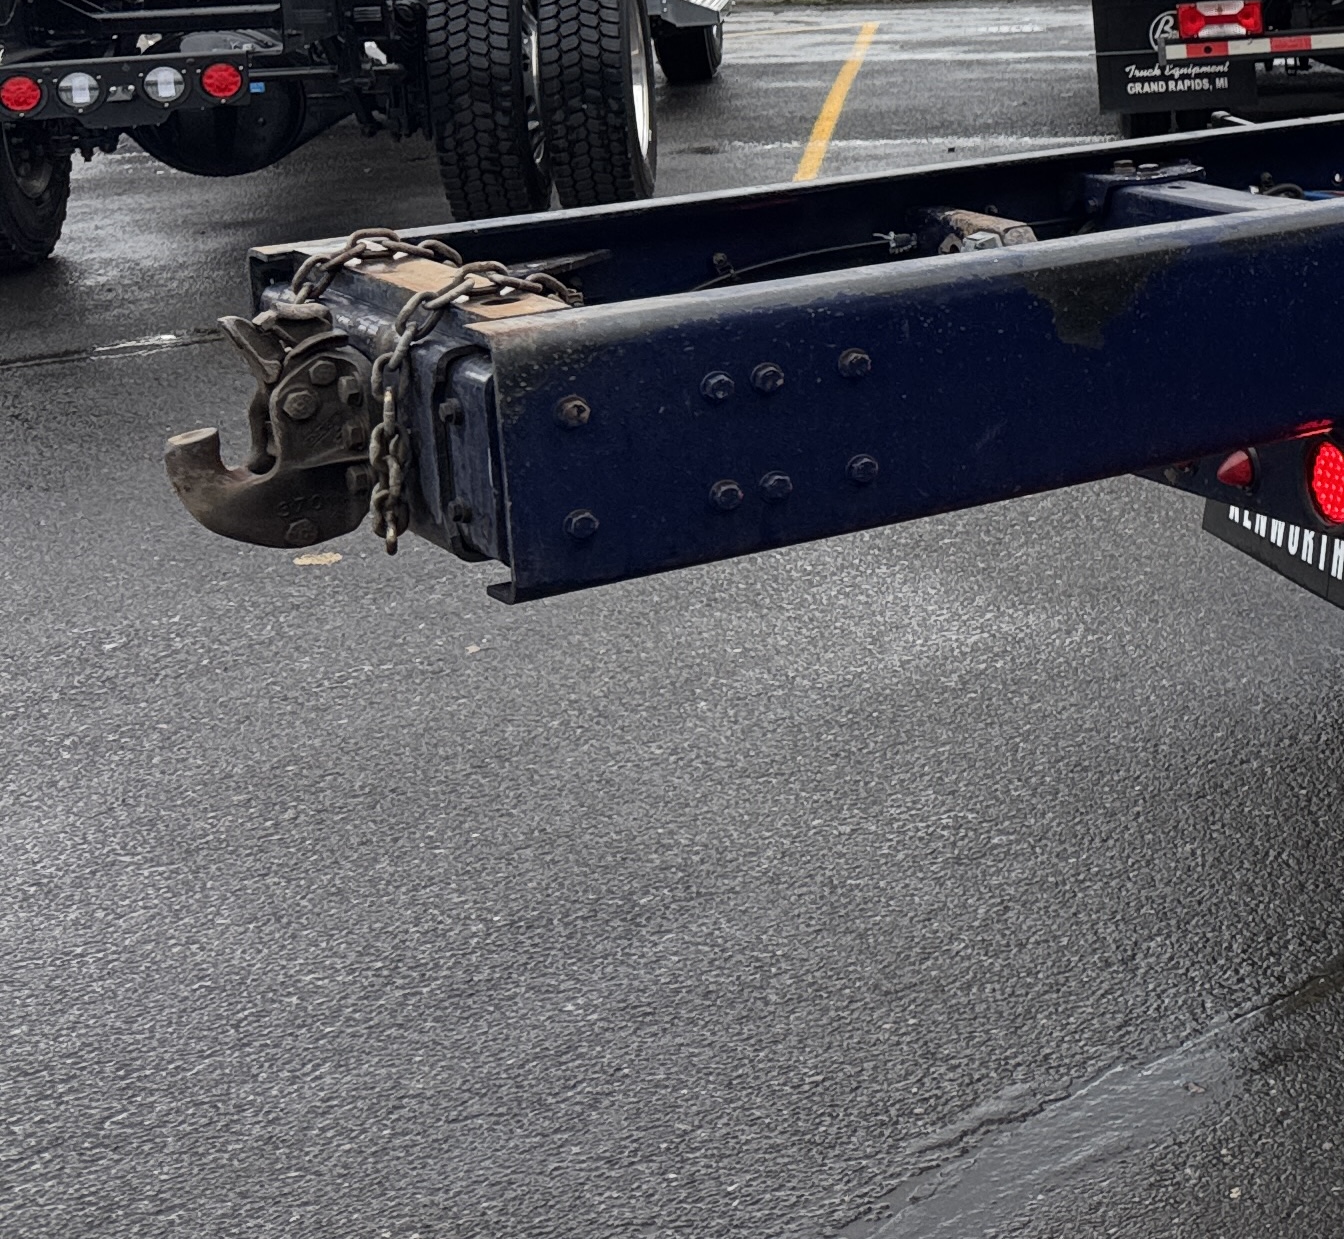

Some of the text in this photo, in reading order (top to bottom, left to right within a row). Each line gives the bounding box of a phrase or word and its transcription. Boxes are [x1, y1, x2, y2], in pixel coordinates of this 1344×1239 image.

[1125, 61, 1230, 79] Truck Equipment
[1127, 77, 1229, 94] GRAND RAPIDS, MI
